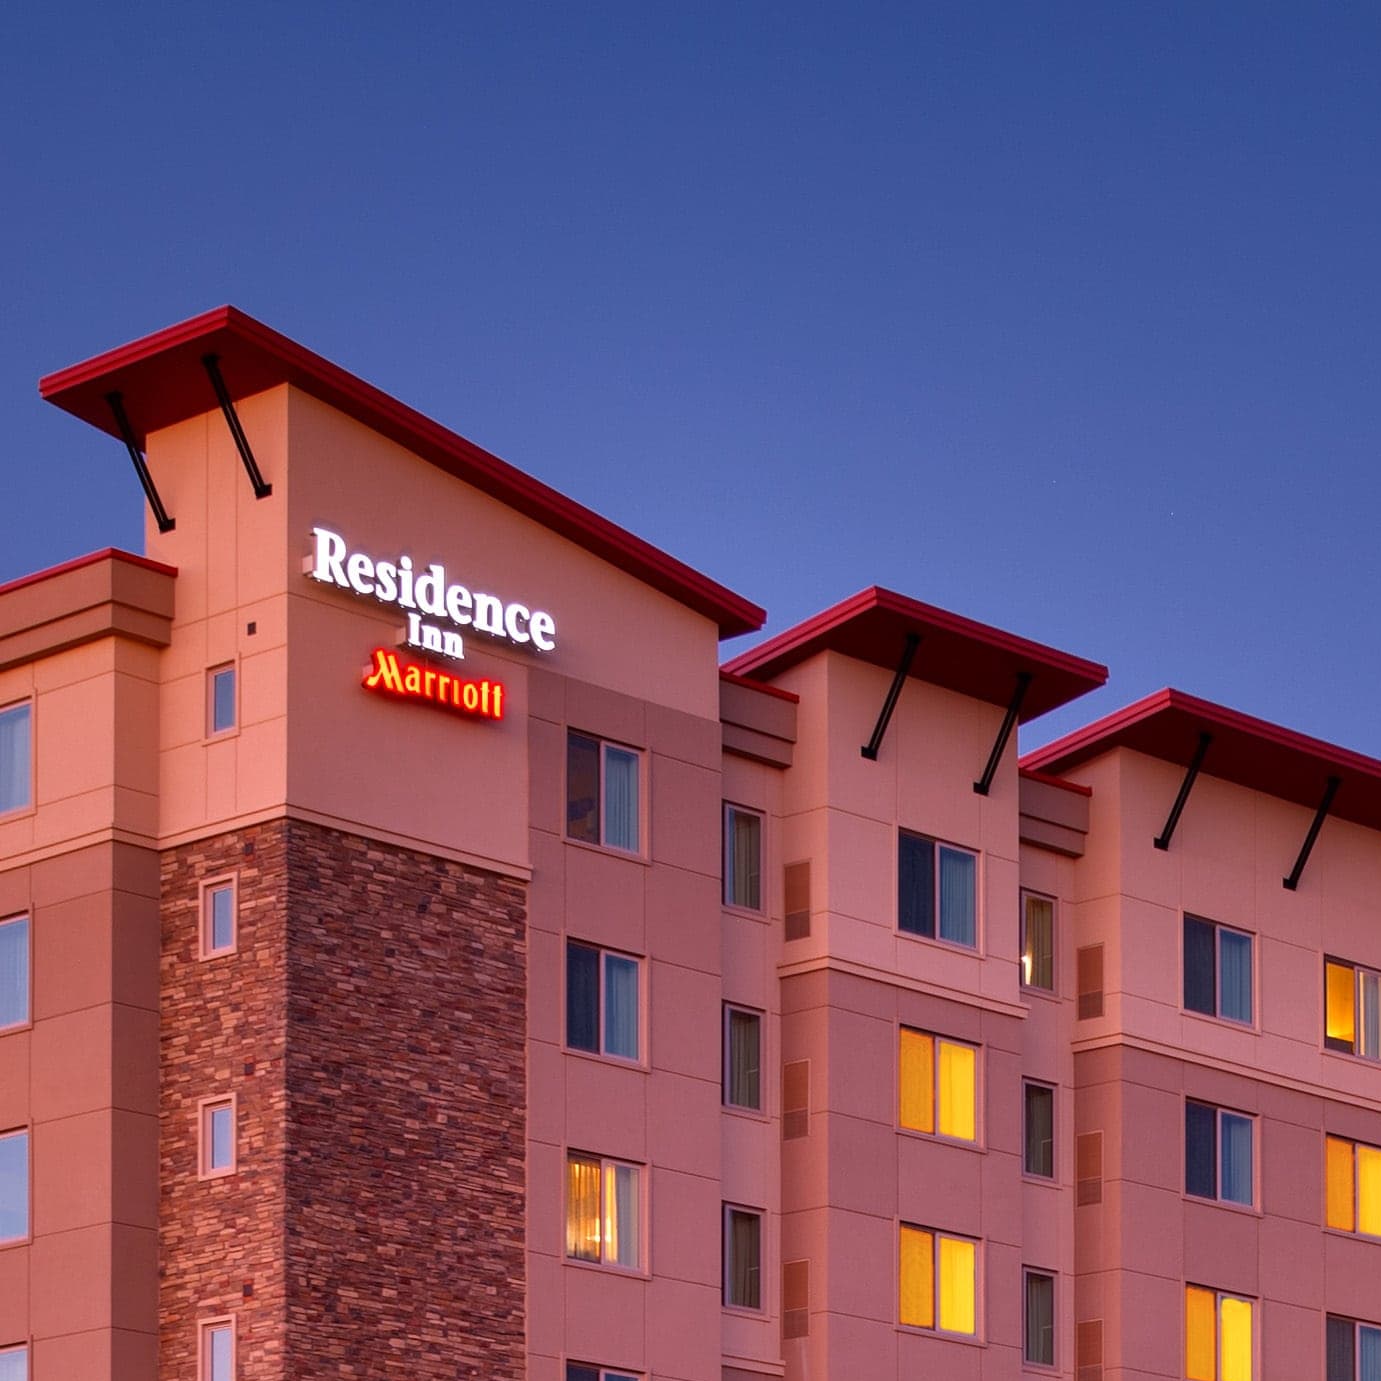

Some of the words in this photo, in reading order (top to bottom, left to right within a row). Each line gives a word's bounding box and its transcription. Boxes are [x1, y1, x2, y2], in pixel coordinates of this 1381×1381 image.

[313, 527, 556, 651] Residence
[407, 612, 465, 660] Inn
[364, 648, 504, 719] Marriott
